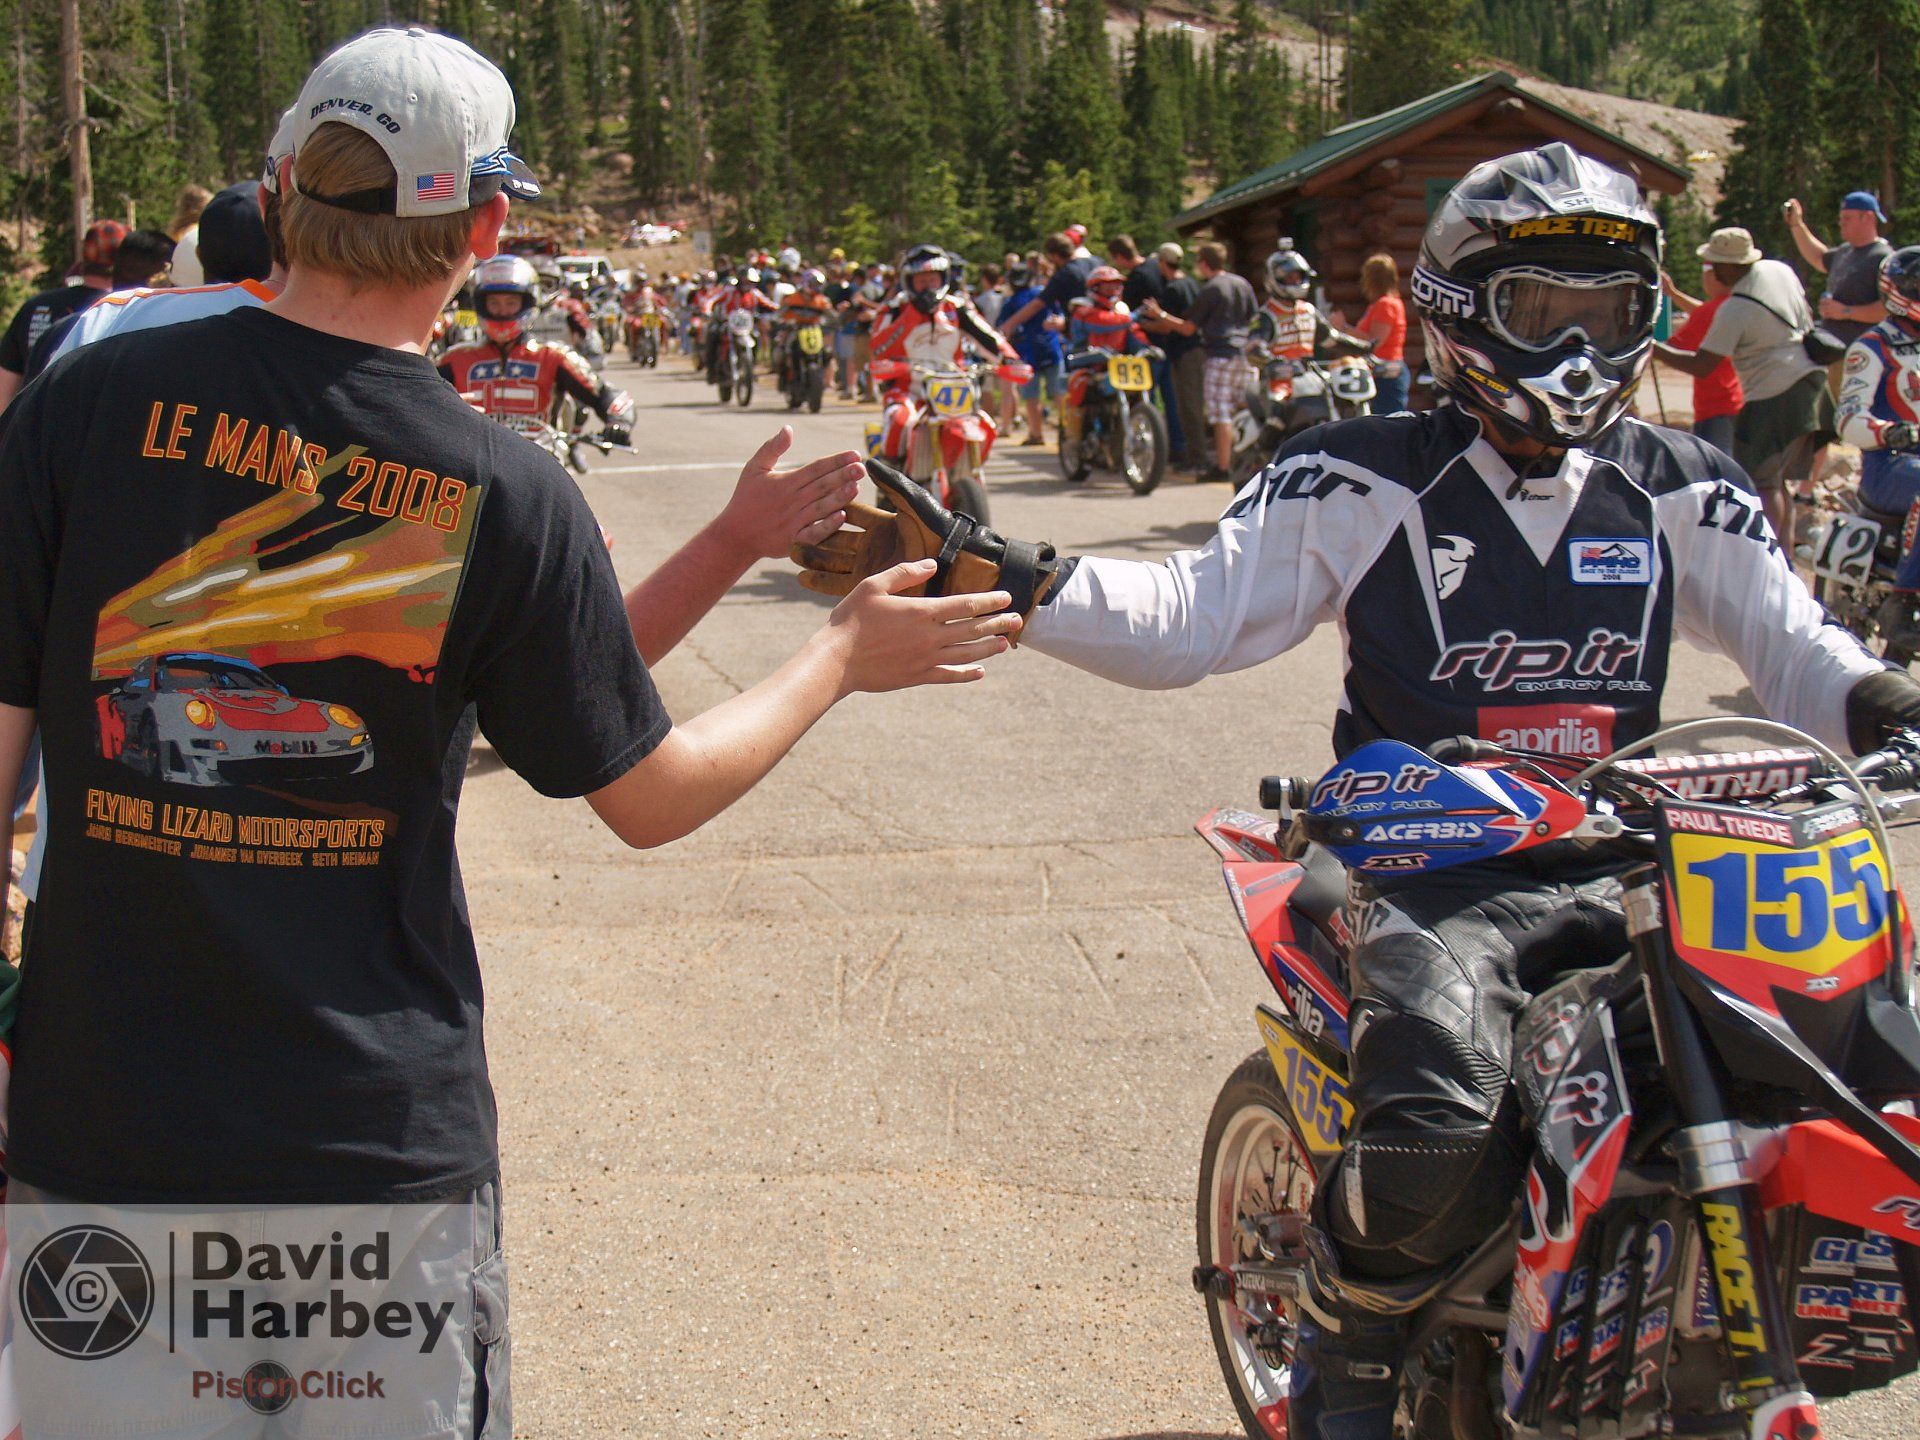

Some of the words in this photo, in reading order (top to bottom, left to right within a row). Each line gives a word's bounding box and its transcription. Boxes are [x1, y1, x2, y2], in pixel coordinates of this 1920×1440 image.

[376, 113, 400, 134] CO
[1509, 217, 1576, 239] RACE
[1581, 217, 1636, 243] TECH
[1410, 266, 1476, 318] COTT
[1117, 364, 1145, 385] 93
[935, 386, 970, 406] 47
[143, 402, 198, 460] LE
[205, 413, 328, 496] MANS
[338, 457, 468, 533] 2008
[1816, 518, 1876, 578] 12
[1429, 629, 1571, 691] rip
[1574, 627, 1640, 677] it
[1516, 680, 1603, 692] ENERGY
[1607, 680, 1652, 691] FUEL
[1496, 718, 1601, 754] aprilia
[1613, 749, 1818, 773] RENTHAL
[1311, 768, 1391, 807] rip
[1392, 763, 1441, 793] it
[87, 788, 153, 831] FLYING
[162, 804, 234, 843] LIZARD
[238, 815, 385, 848] MOTORSPORTS
[1320, 802, 1387, 817] NERGY
[1392, 800, 1443, 810] FUEL
[1665, 809, 1721, 831] PAUL
[1725, 814, 1796, 845] THEDE
[1688, 839, 1887, 953] 155
[1283, 1047, 1350, 1145] 155
[1702, 1203, 1761, 1317] RACE
[1799, 1279, 1905, 1307] PART
